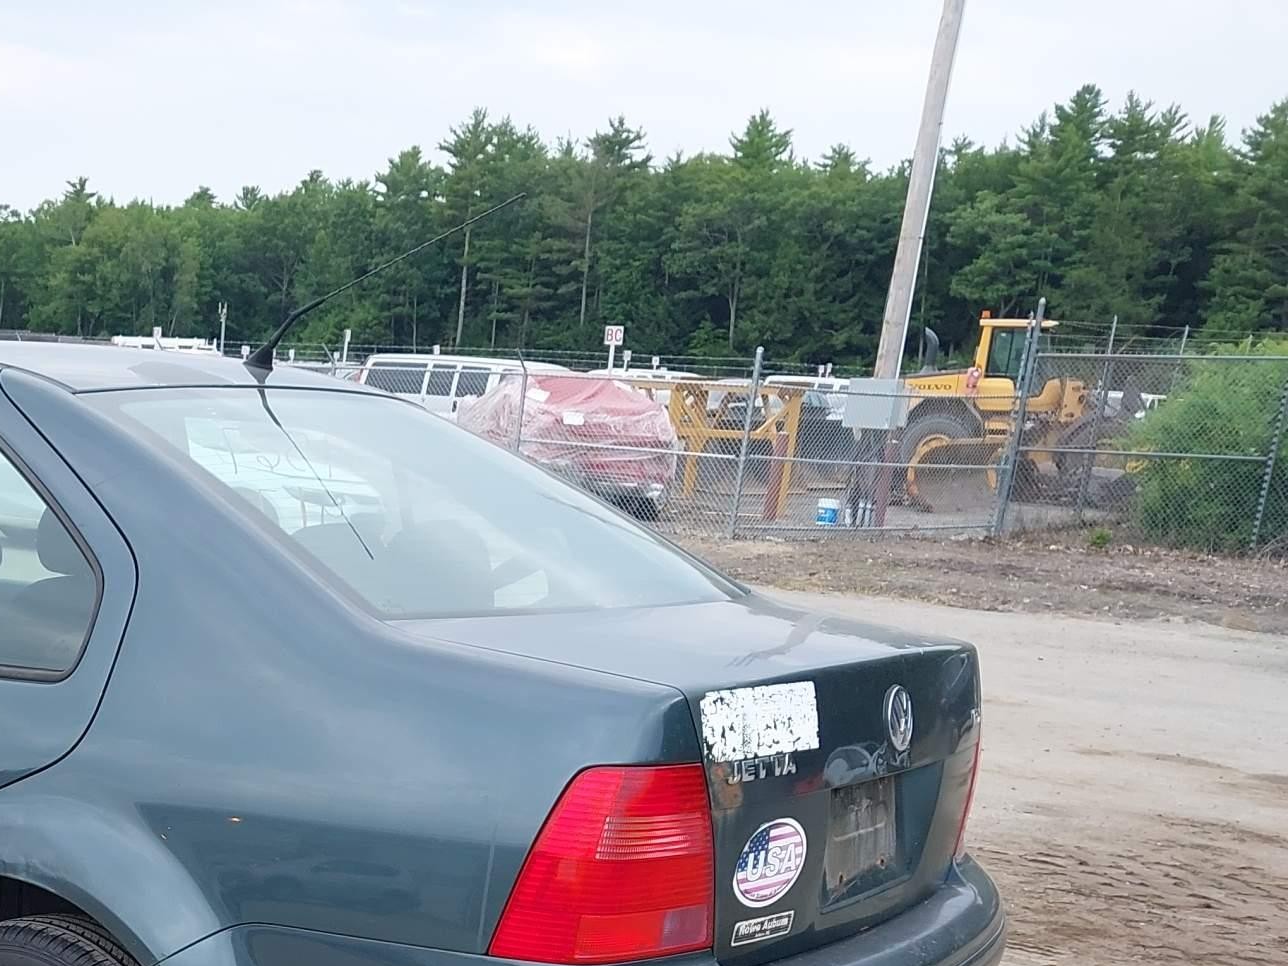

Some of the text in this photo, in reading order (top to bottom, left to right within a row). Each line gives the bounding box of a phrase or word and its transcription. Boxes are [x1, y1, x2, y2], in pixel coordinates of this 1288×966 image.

[607, 328, 623, 342] BC
[728, 753, 797, 785] JETTA
[746, 843, 796, 882] USA
